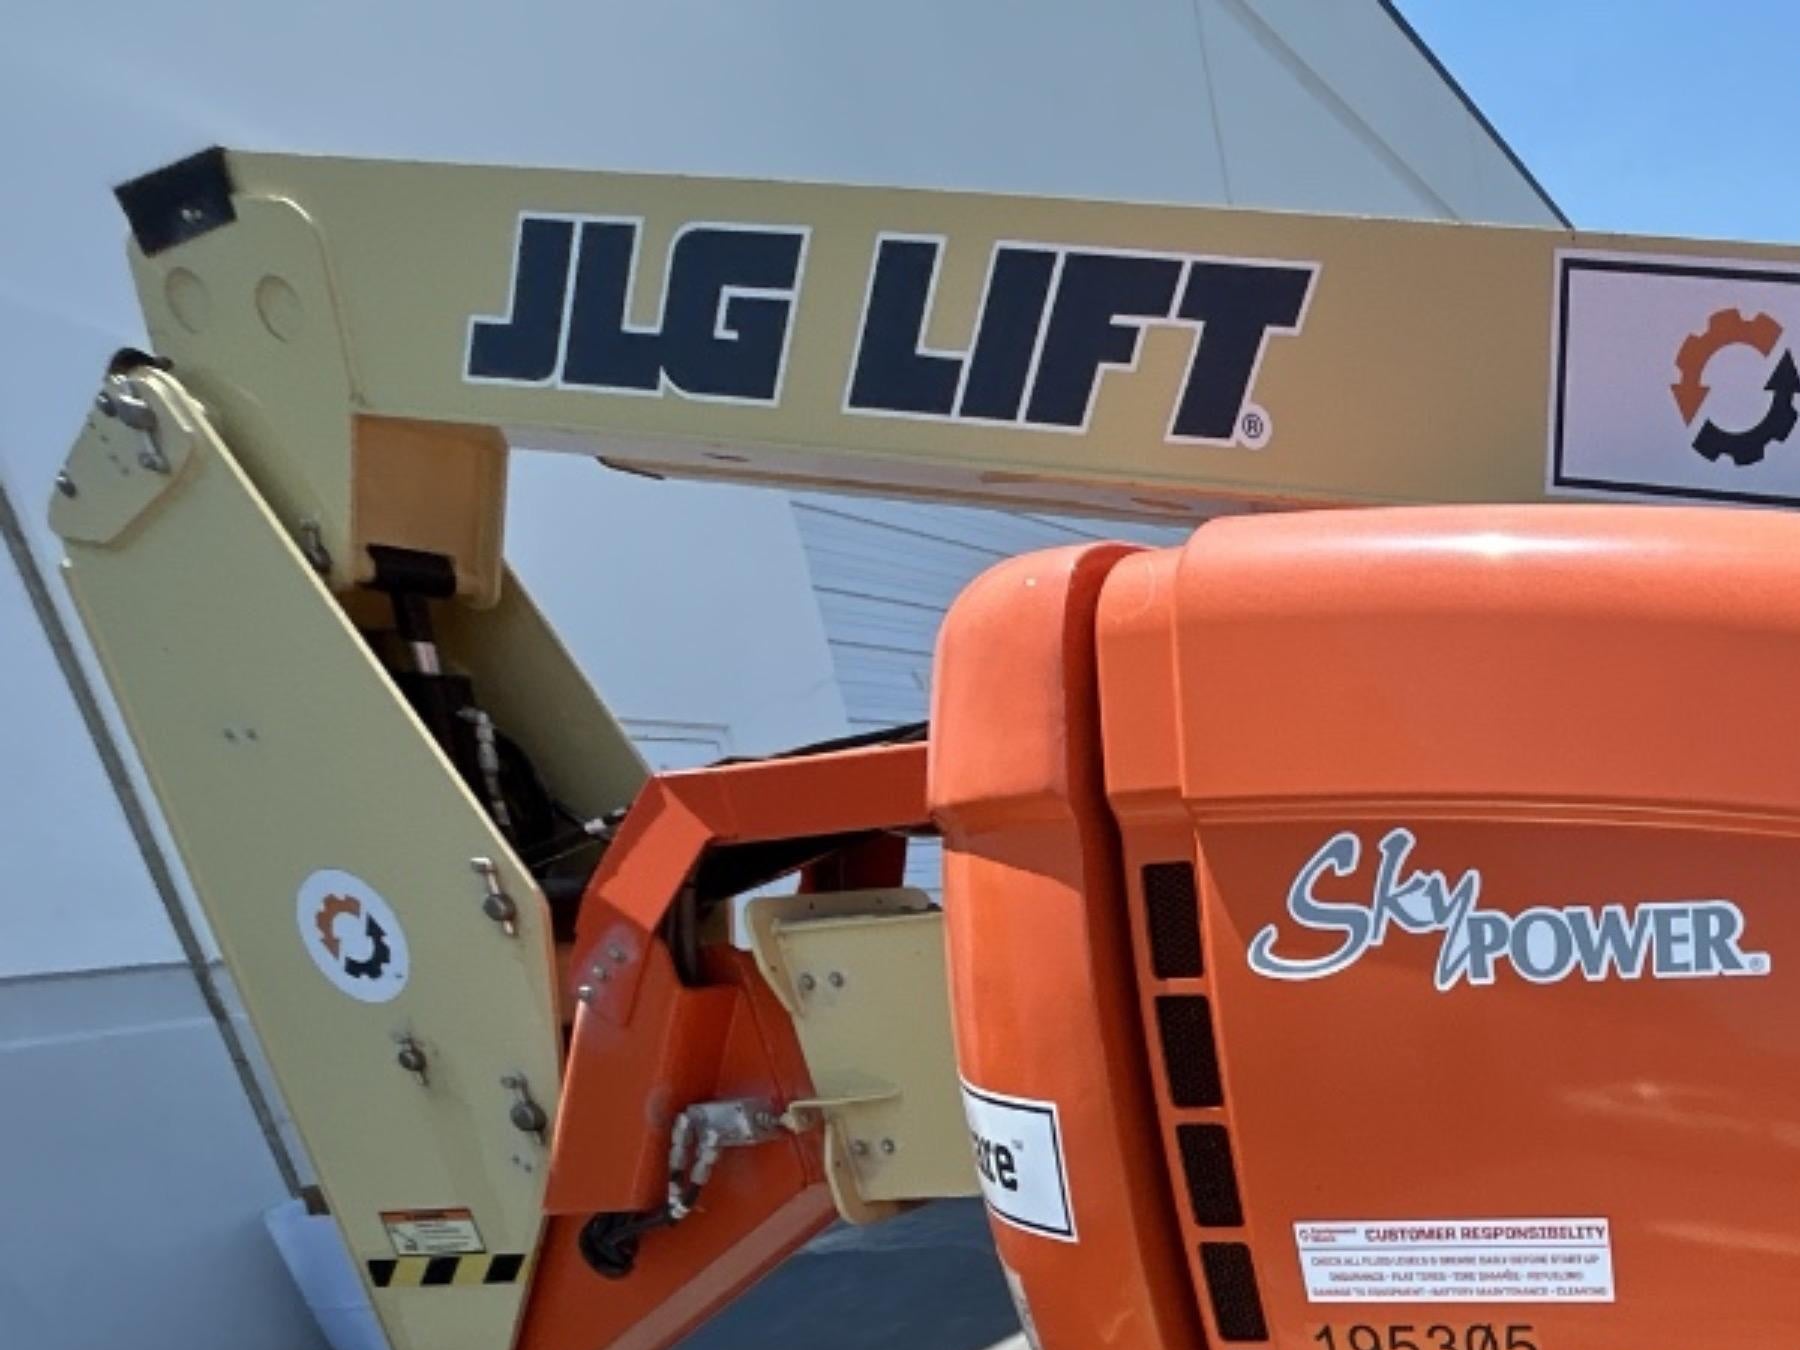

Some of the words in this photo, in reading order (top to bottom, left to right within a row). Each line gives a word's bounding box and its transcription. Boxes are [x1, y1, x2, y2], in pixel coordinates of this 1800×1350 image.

[462, 210, 811, 406] JLG
[844, 232, 1320, 446] LIFT
[1364, 1226, 1456, 1243] CUSTOMER
[1460, 1225, 1606, 1241] RESPONSIBILITY
